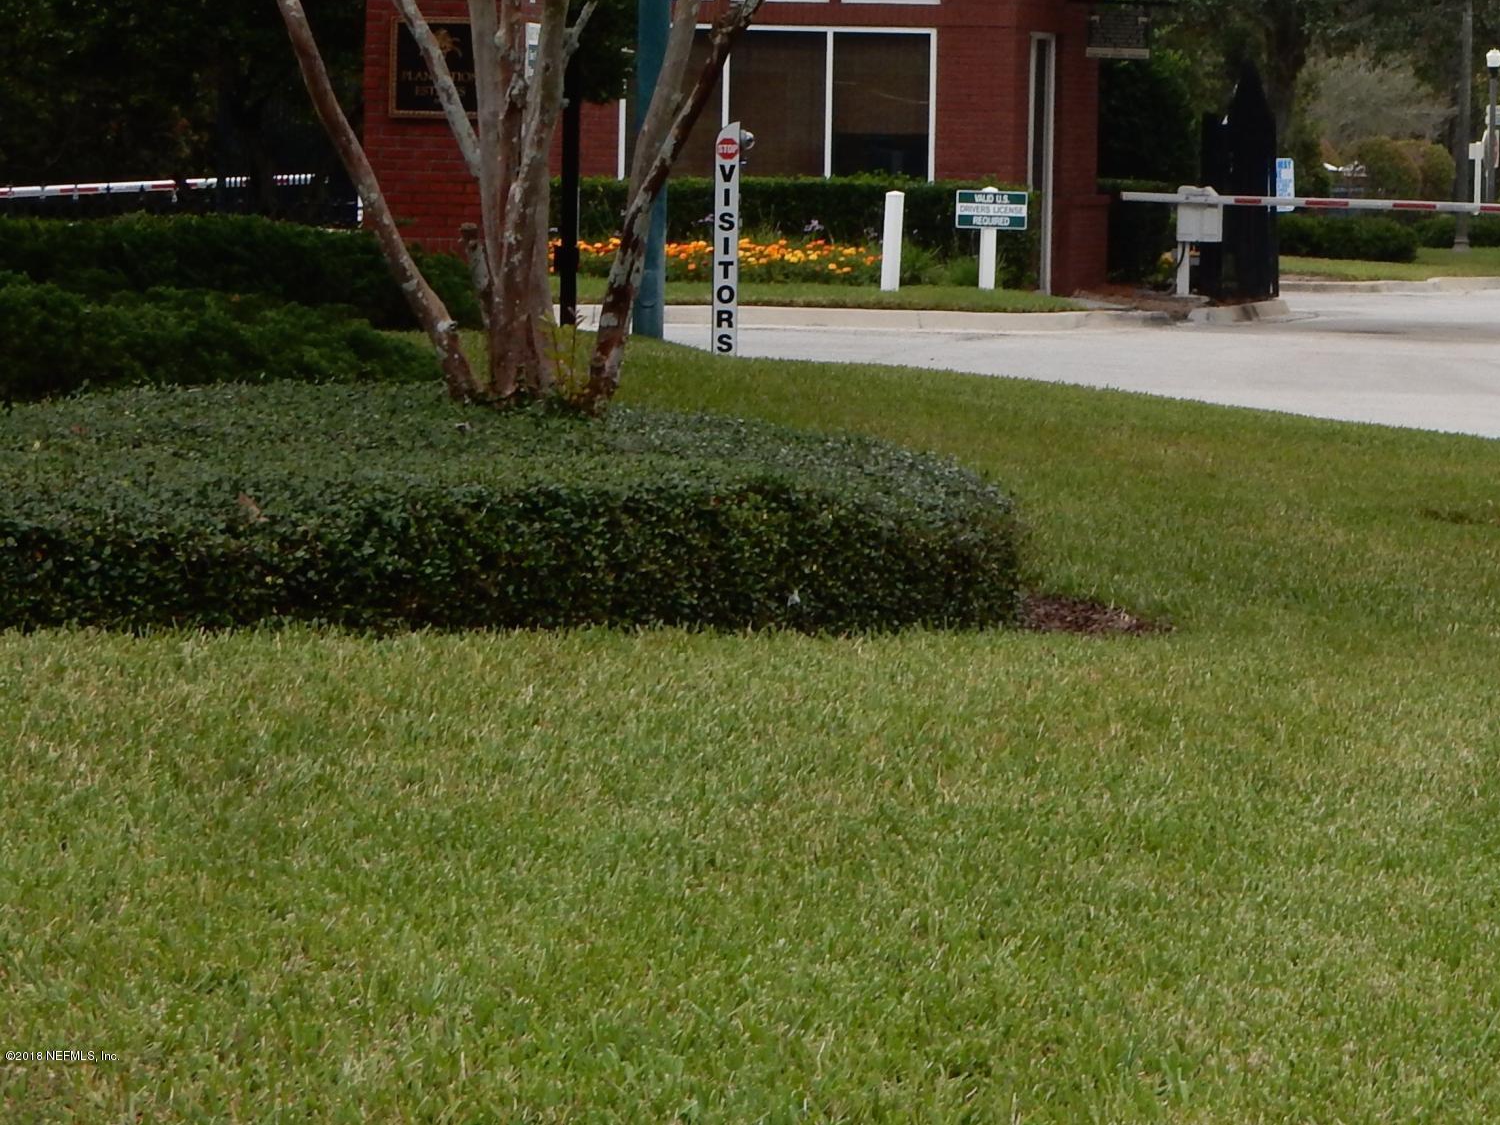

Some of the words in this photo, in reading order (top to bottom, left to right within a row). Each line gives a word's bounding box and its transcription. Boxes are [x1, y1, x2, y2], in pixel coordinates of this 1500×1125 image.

[717, 144, 739, 154] STOP
[974, 193, 994, 203] VALID
[995, 194, 1011, 204] U.S.
[960, 205, 991, 214] DRIVERS
[993, 205, 1025, 215] LICENSE
[972, 216, 1010, 226] REQUIRED
[716, 164, 737, 353] VISITORS
